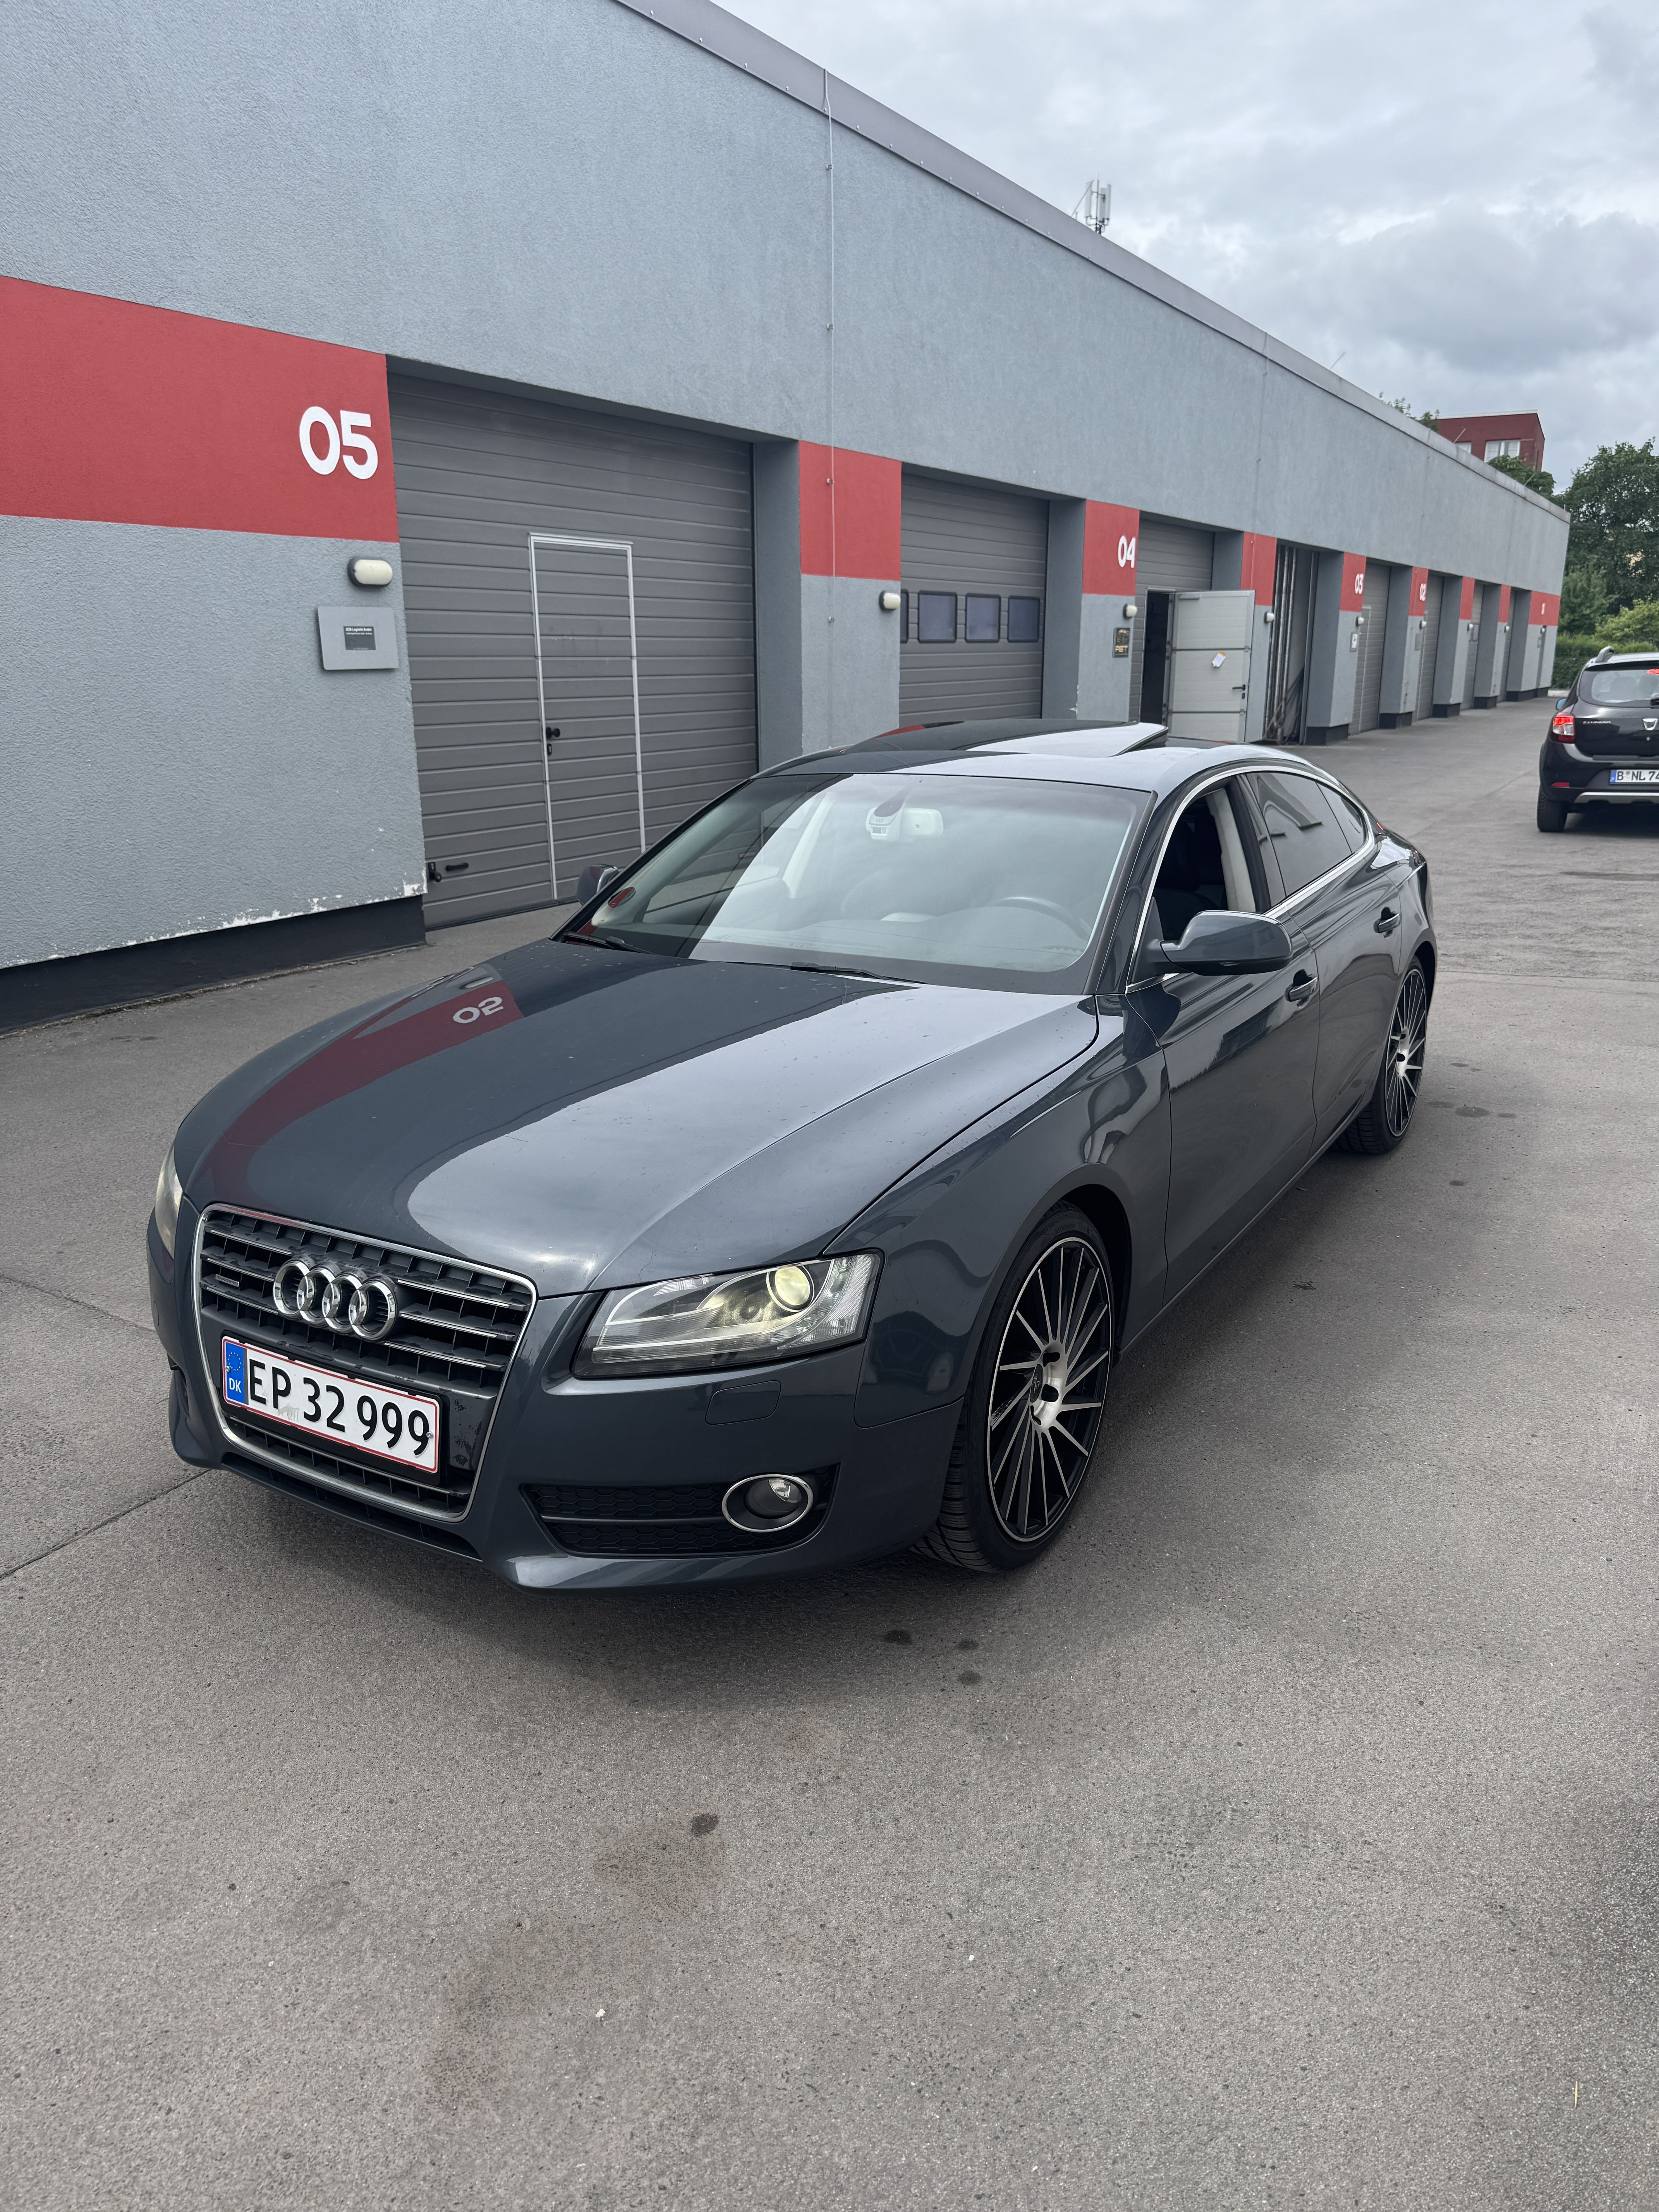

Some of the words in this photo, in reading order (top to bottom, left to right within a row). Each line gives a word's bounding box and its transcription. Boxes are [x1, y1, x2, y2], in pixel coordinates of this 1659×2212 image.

[299, 406, 378, 480] 05
[1118, 535, 1136, 568] 04
[1355, 573, 1364, 594] 03
[1617, 771, 1624, 781] B
[1631, 771, 1645, 781] NL
[228, 1377, 242, 1394] DK
[249, 1358, 291, 1409] EP
[303, 1377, 345, 1432] 32
[357, 1395, 430, 1457] 999
